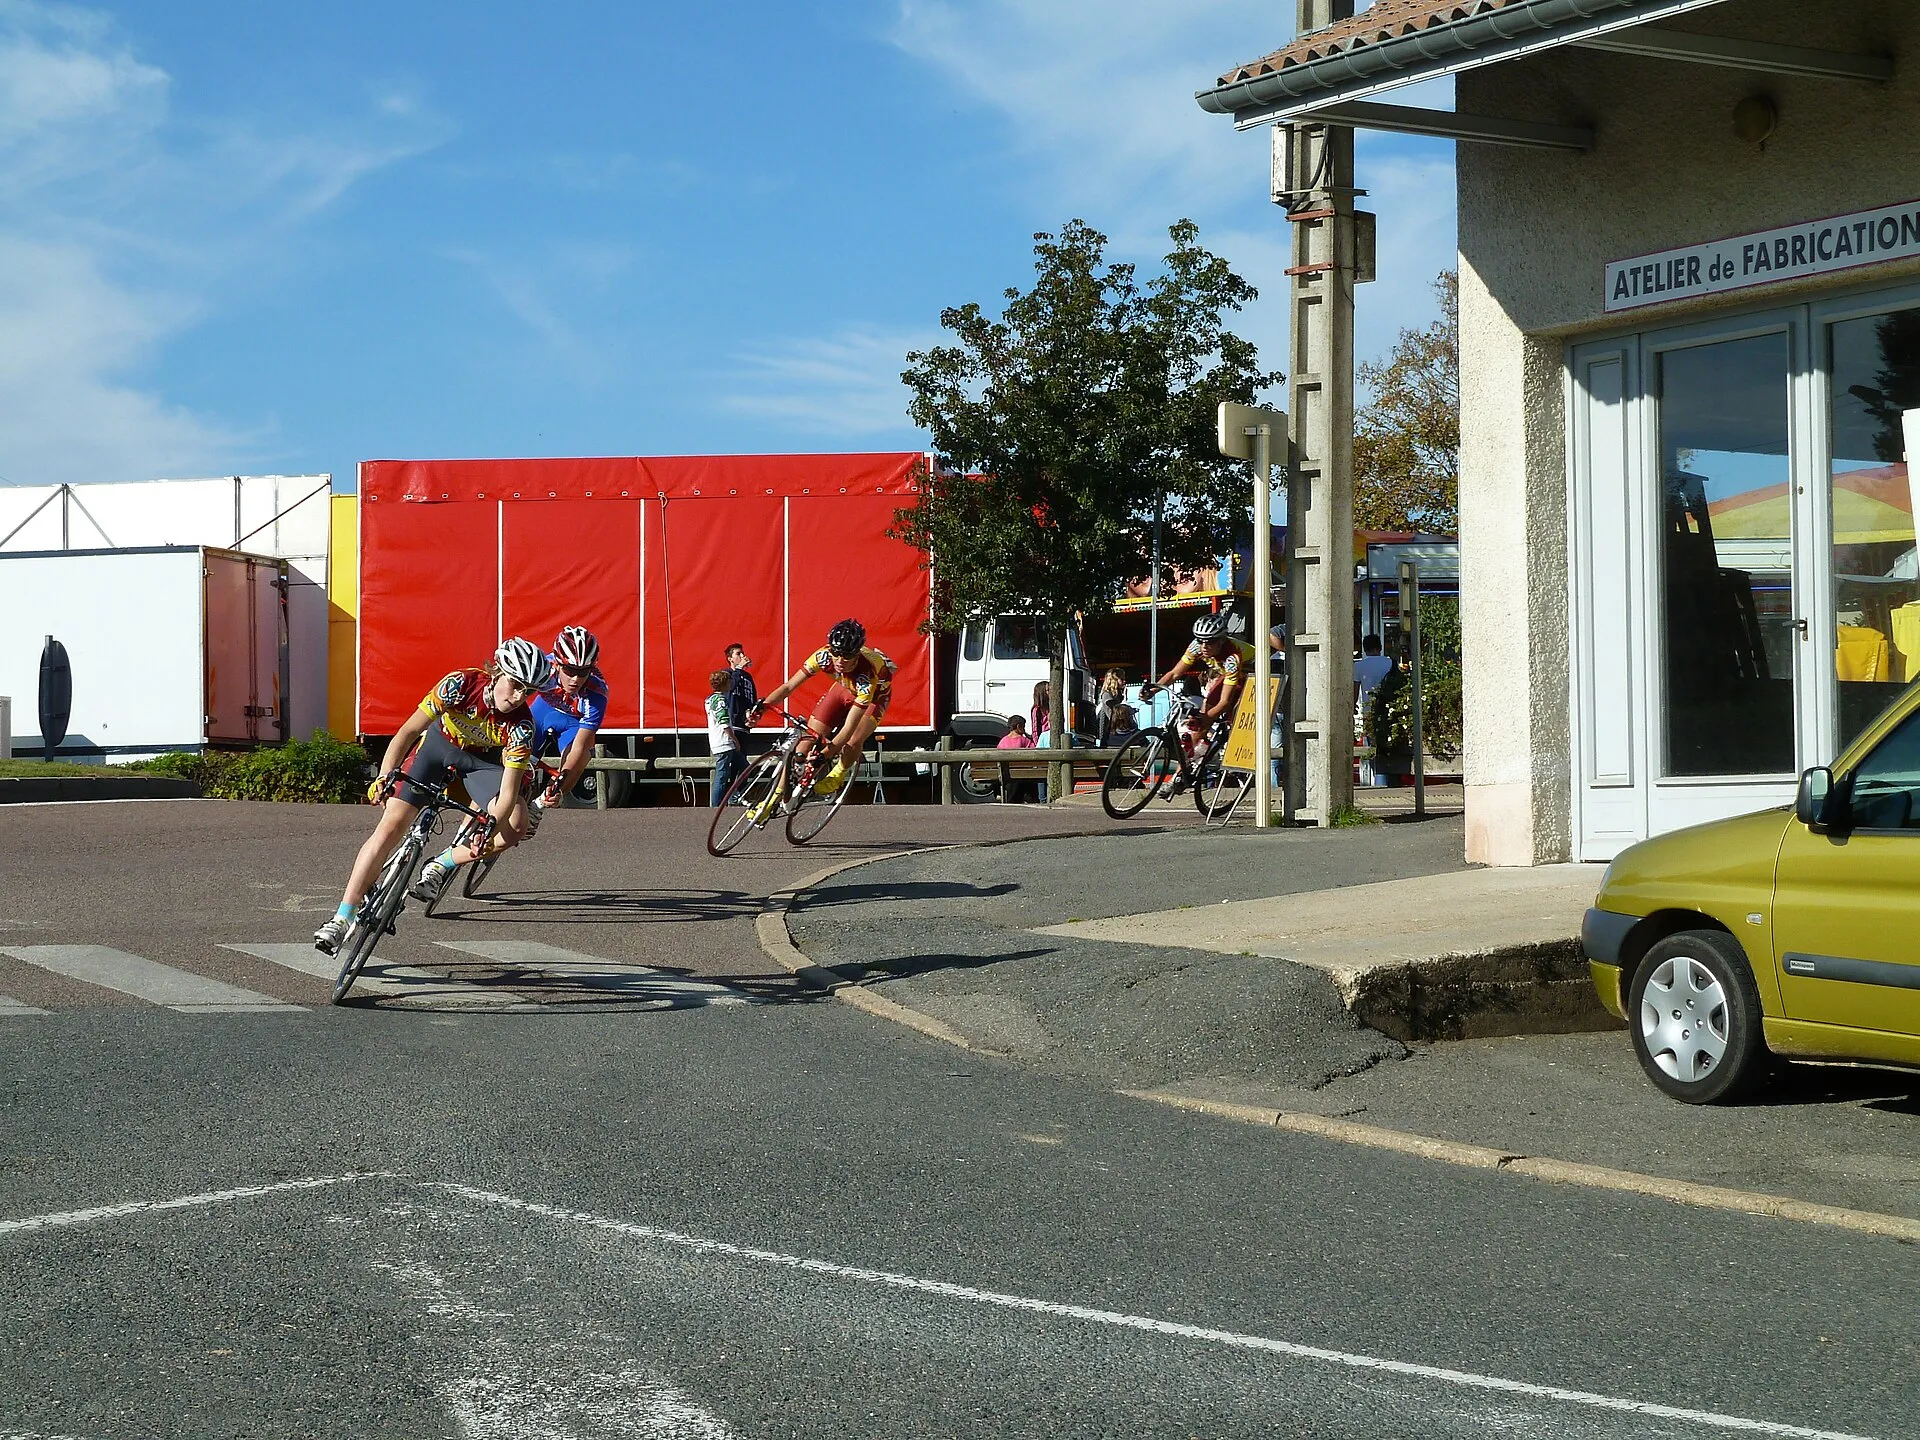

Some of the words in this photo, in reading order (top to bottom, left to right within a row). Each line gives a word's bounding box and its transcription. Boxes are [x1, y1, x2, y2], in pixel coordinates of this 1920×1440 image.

[1613, 255, 1702, 300] ATELIER
[1708, 253, 1735, 282] de
[1743, 211, 1920, 276] FABRICATION
